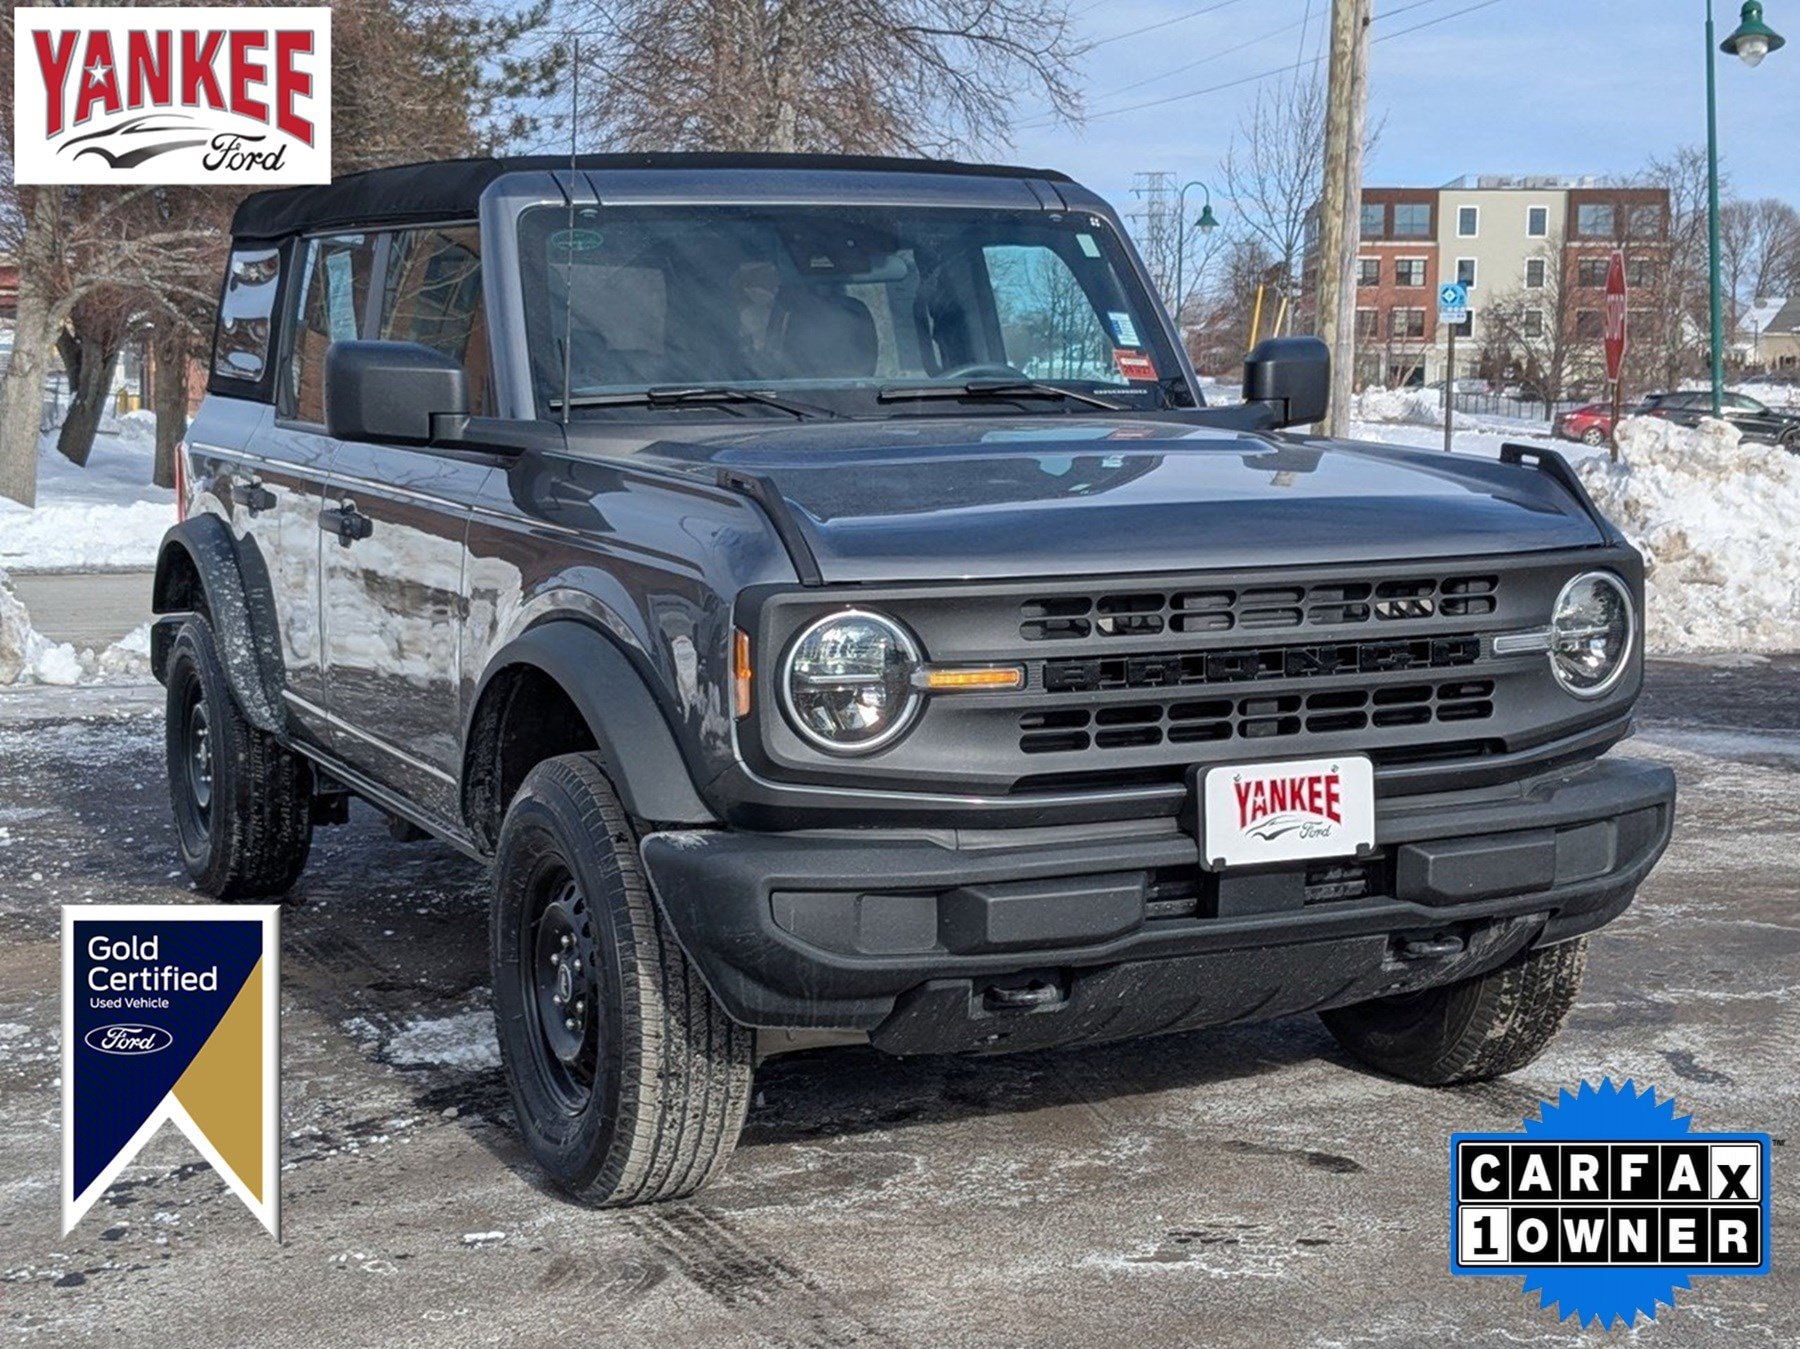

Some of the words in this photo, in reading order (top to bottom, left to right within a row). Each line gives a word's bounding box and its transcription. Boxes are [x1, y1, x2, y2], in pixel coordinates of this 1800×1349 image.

[1043, 640, 1480, 691] BRONCO
[1234, 774, 1341, 830] YANKEE
[1299, 821, 1333, 839] Ford
